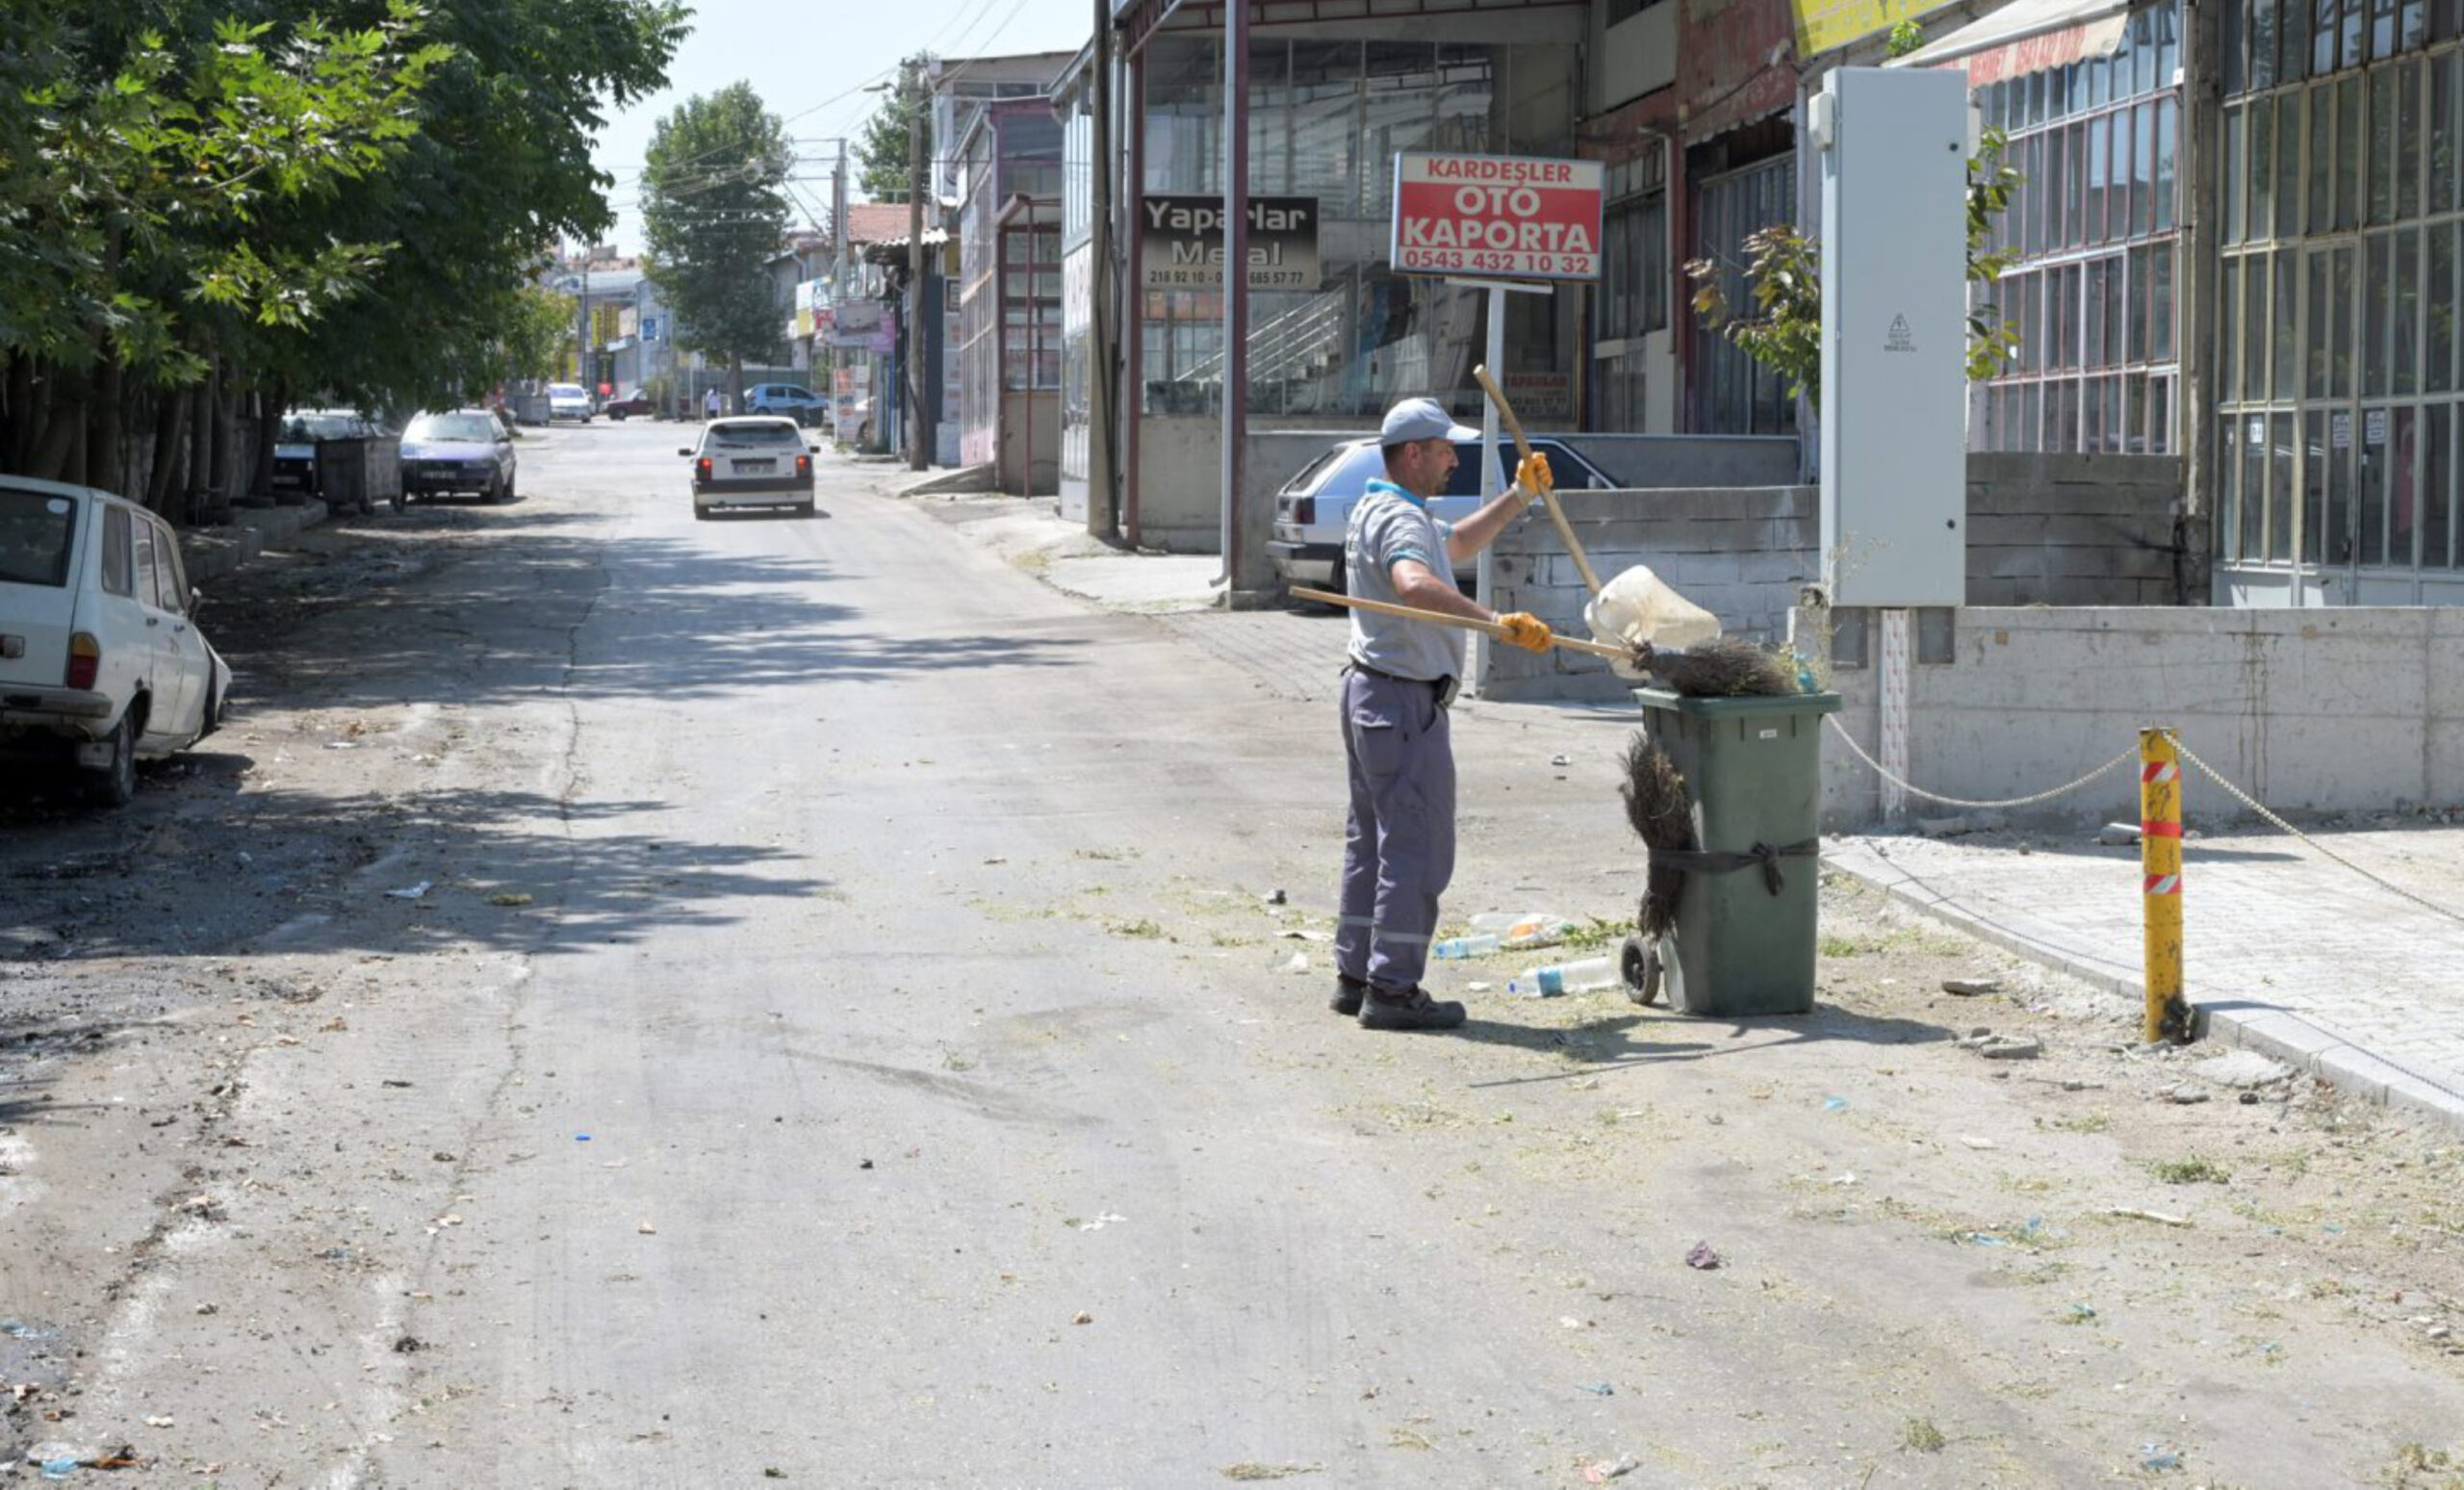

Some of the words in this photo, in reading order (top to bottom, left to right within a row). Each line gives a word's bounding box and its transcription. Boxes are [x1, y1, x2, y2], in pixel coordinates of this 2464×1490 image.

[1427, 158, 1572, 186] KARDEŞLER
[1454, 185, 1541, 217] OTO
[1145, 200, 1307, 236] Yaplar
[1403, 217, 1593, 252] KAPORTA
[1171, 240, 1282, 266] Meal
[1404, 250, 1463, 269] 0543
[1472, 252, 1516, 270] 432
[1527, 254, 1553, 271] 10
[1561, 256, 1590, 273] 32
[1150, 270, 1171, 283] 218
[1174, 270, 1187, 283] 92
[1193, 271, 1205, 283] 10
[1249, 271, 1270, 284] 685
[1272, 271, 1287, 284] 57
[1291, 271, 1304, 284] 77
